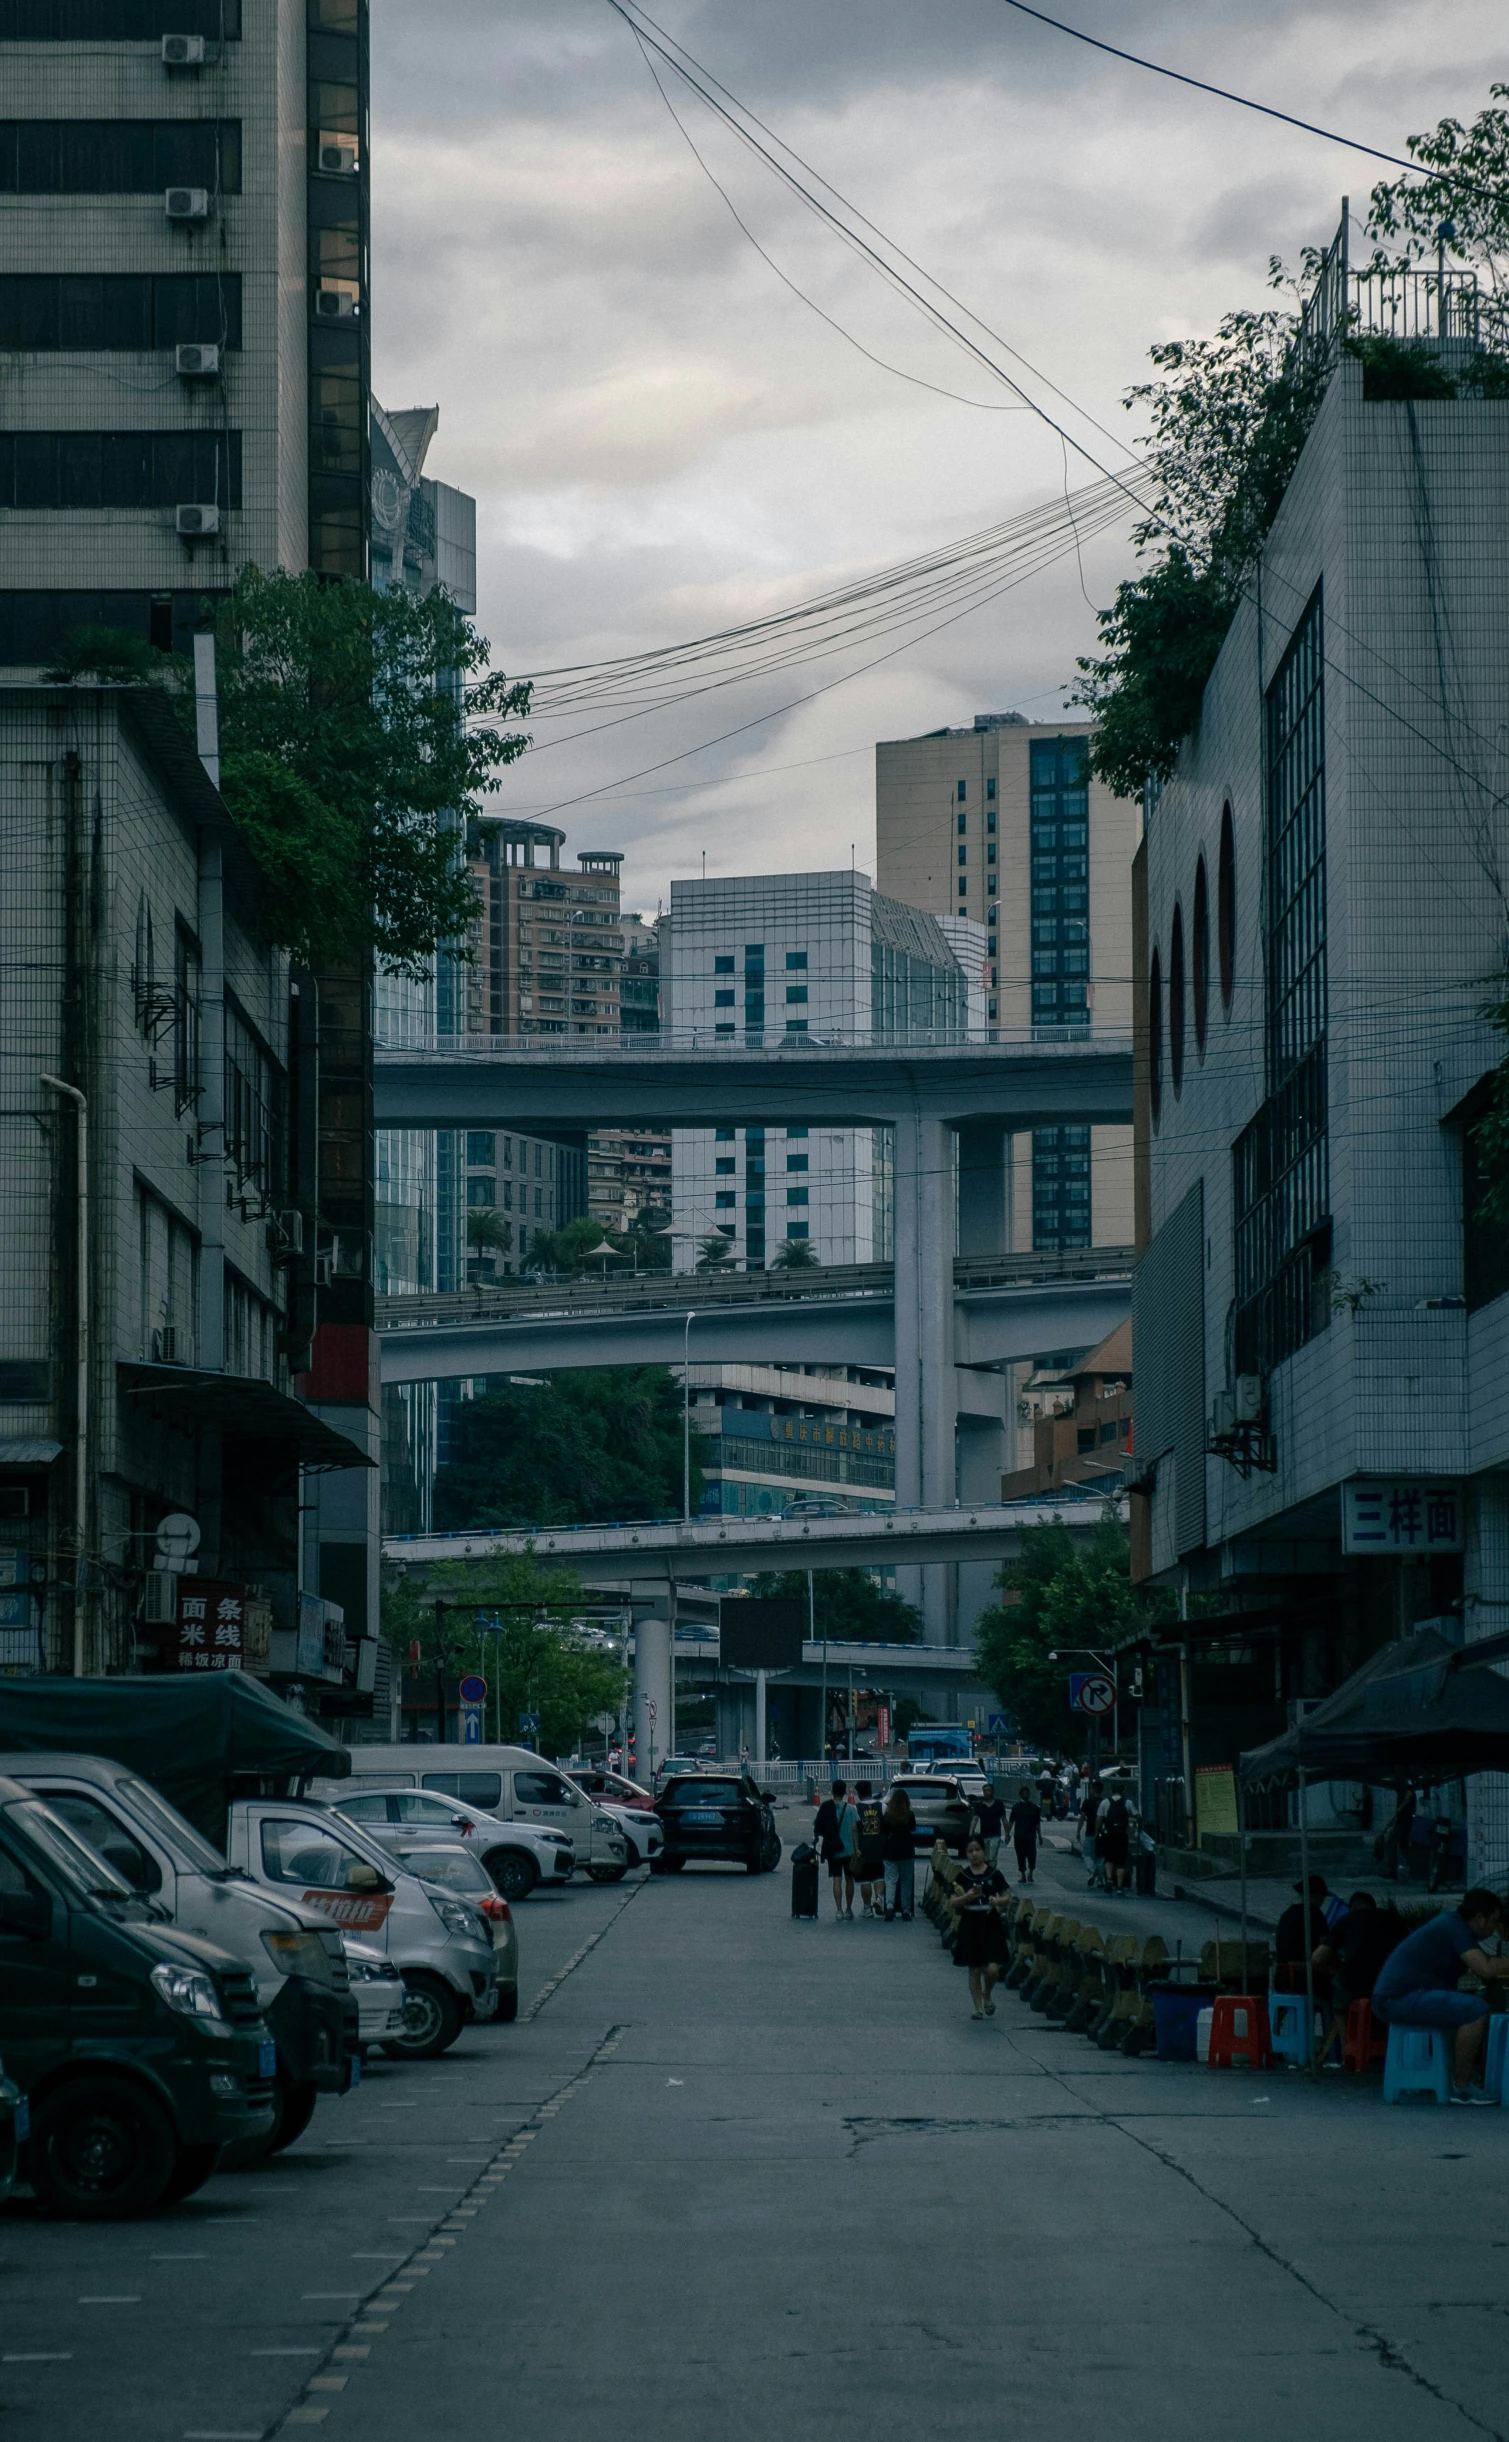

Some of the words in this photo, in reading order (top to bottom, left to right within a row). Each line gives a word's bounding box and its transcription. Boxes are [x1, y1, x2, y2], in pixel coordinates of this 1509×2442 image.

[1353, 1488, 1457, 1545] 三样面
[181, 1597, 243, 1621] 面条
[179, 1623, 242, 1648] 米线
[178, 1652, 243, 1669] 稀饭凉面
[862, 1817, 880, 1836] 23
